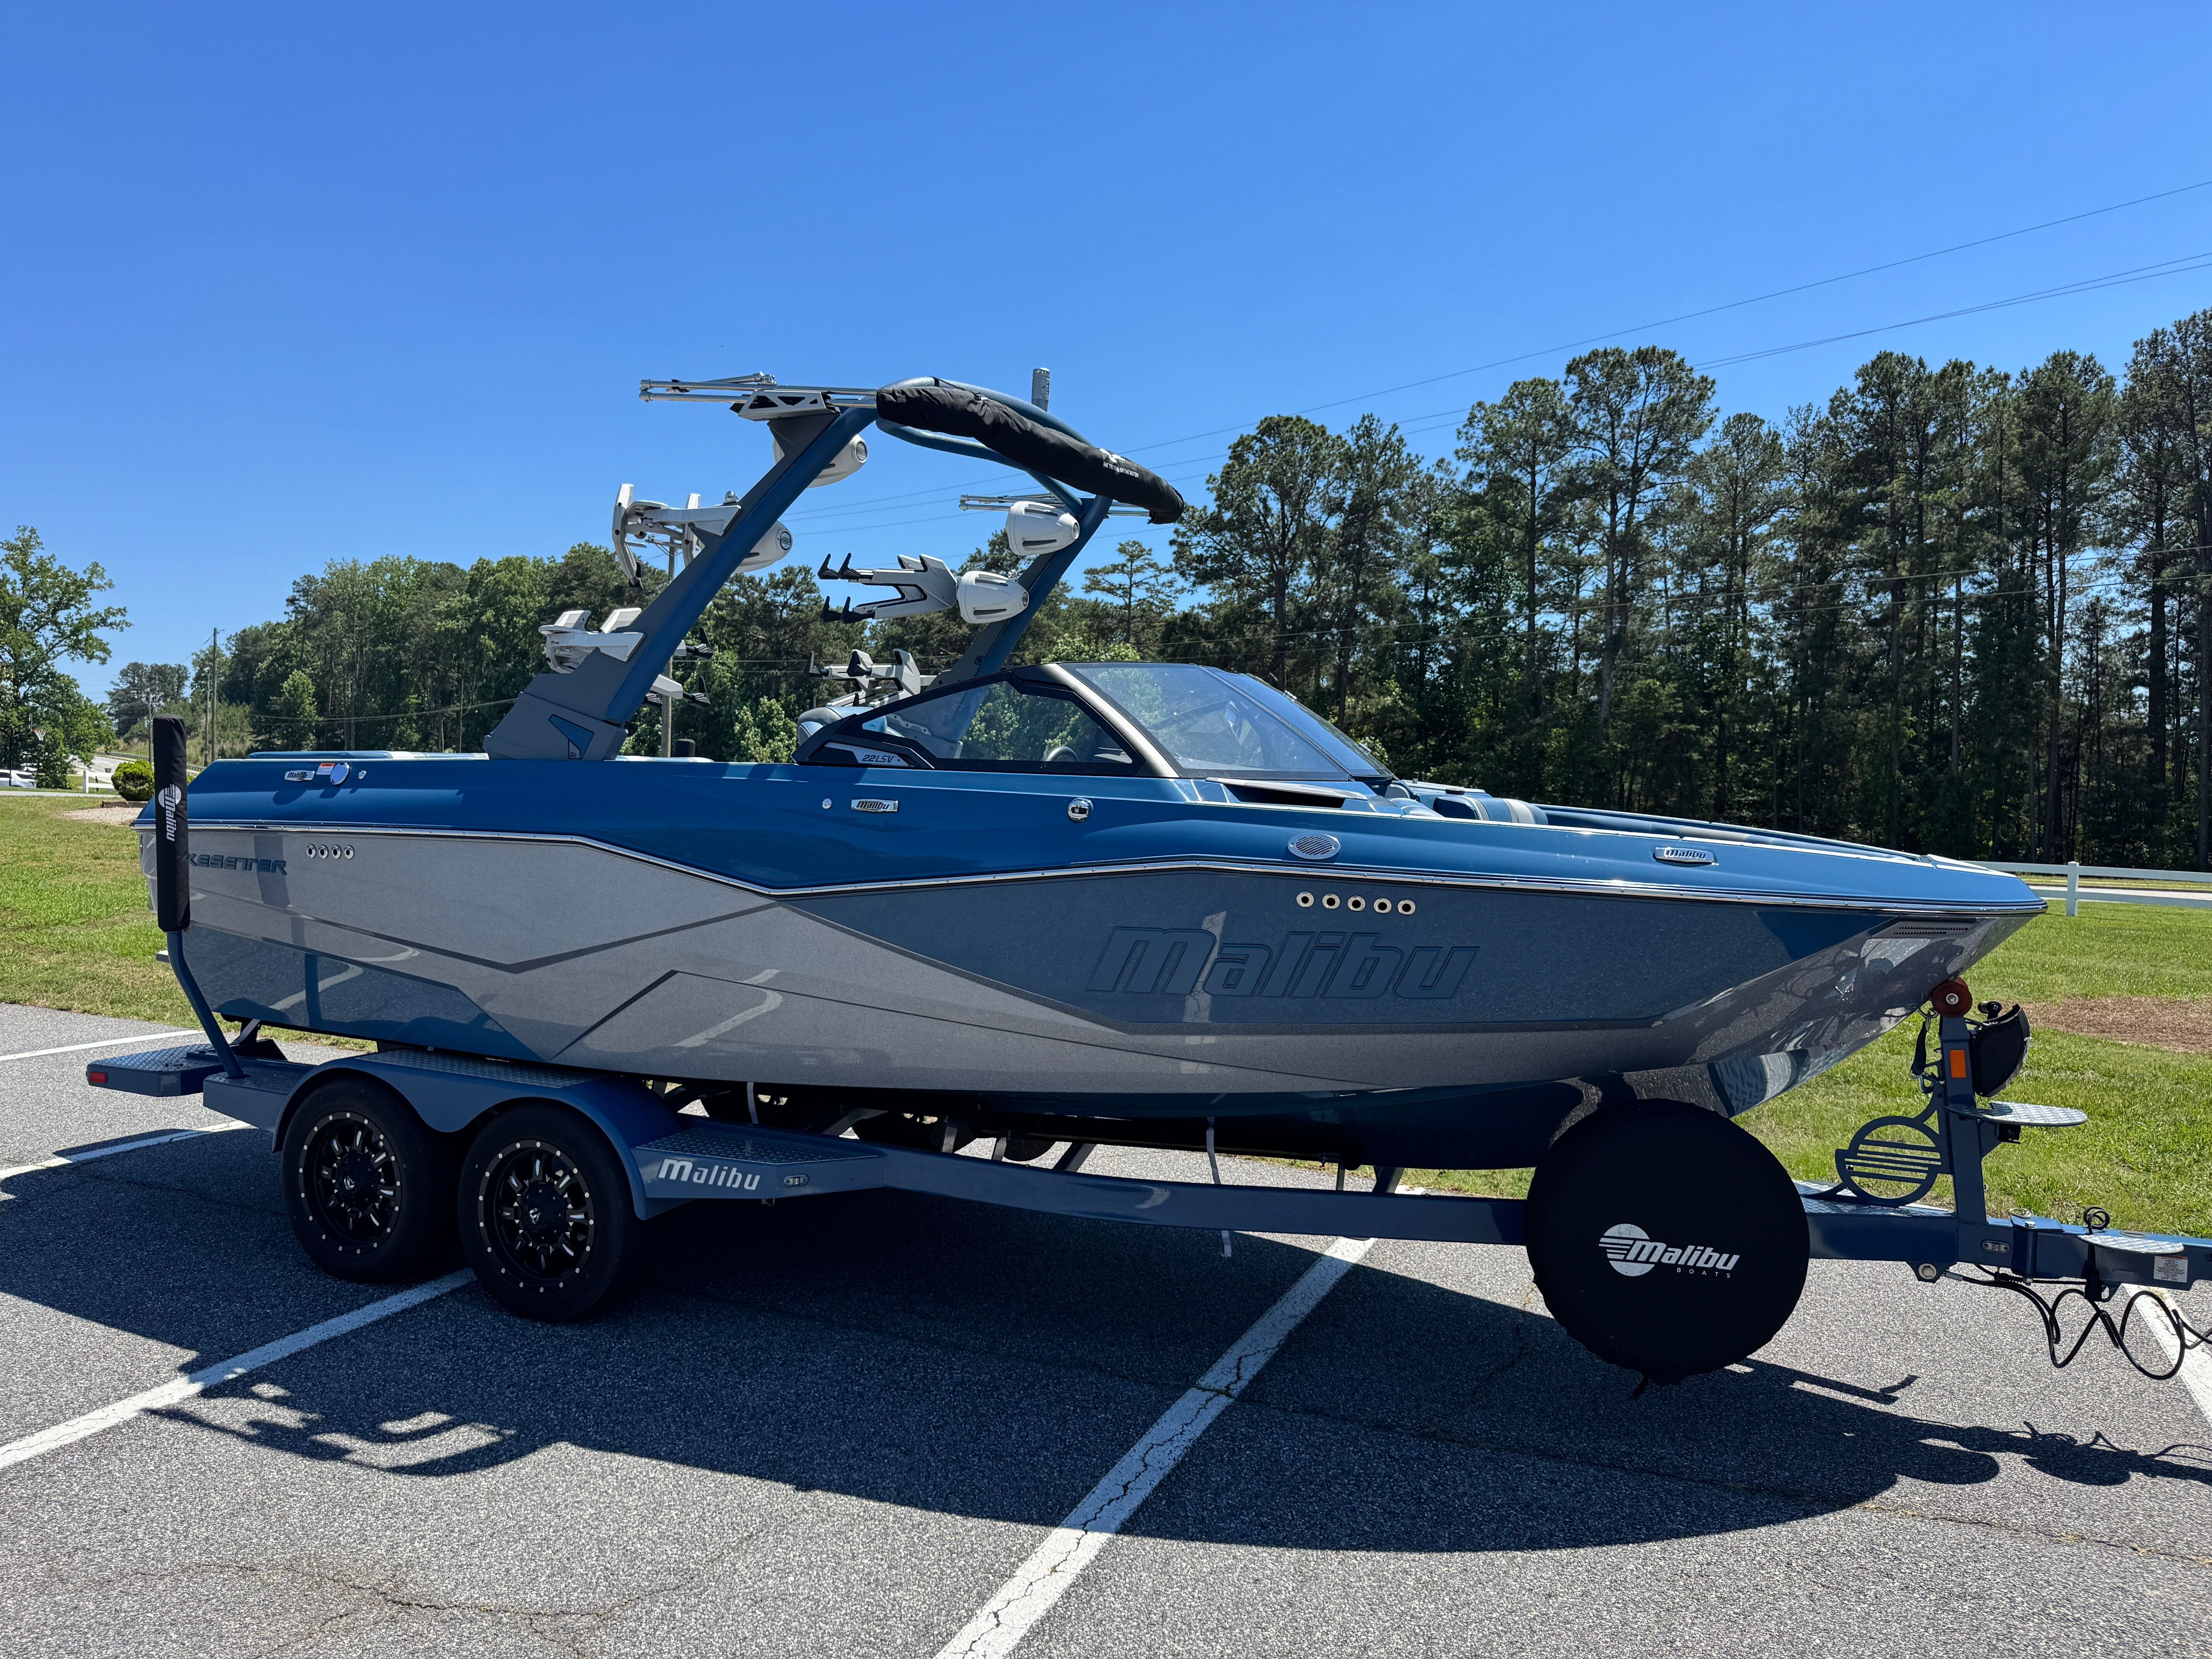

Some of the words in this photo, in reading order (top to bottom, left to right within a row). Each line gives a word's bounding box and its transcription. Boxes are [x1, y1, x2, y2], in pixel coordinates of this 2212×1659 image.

[862, 754, 894, 763] 22LSV
[857, 801, 890, 809] Malibu
[165, 795, 177, 842] Malibu
[189, 854, 287, 875] KESETTER
[1665, 849, 1706, 859] Malibu
[1085, 926, 1480, 999] Malibu
[658, 1159, 761, 1191] Malibu
[1626, 1240, 1740, 1271] Malibu
[1677, 1267, 1731, 1278] BOATS
